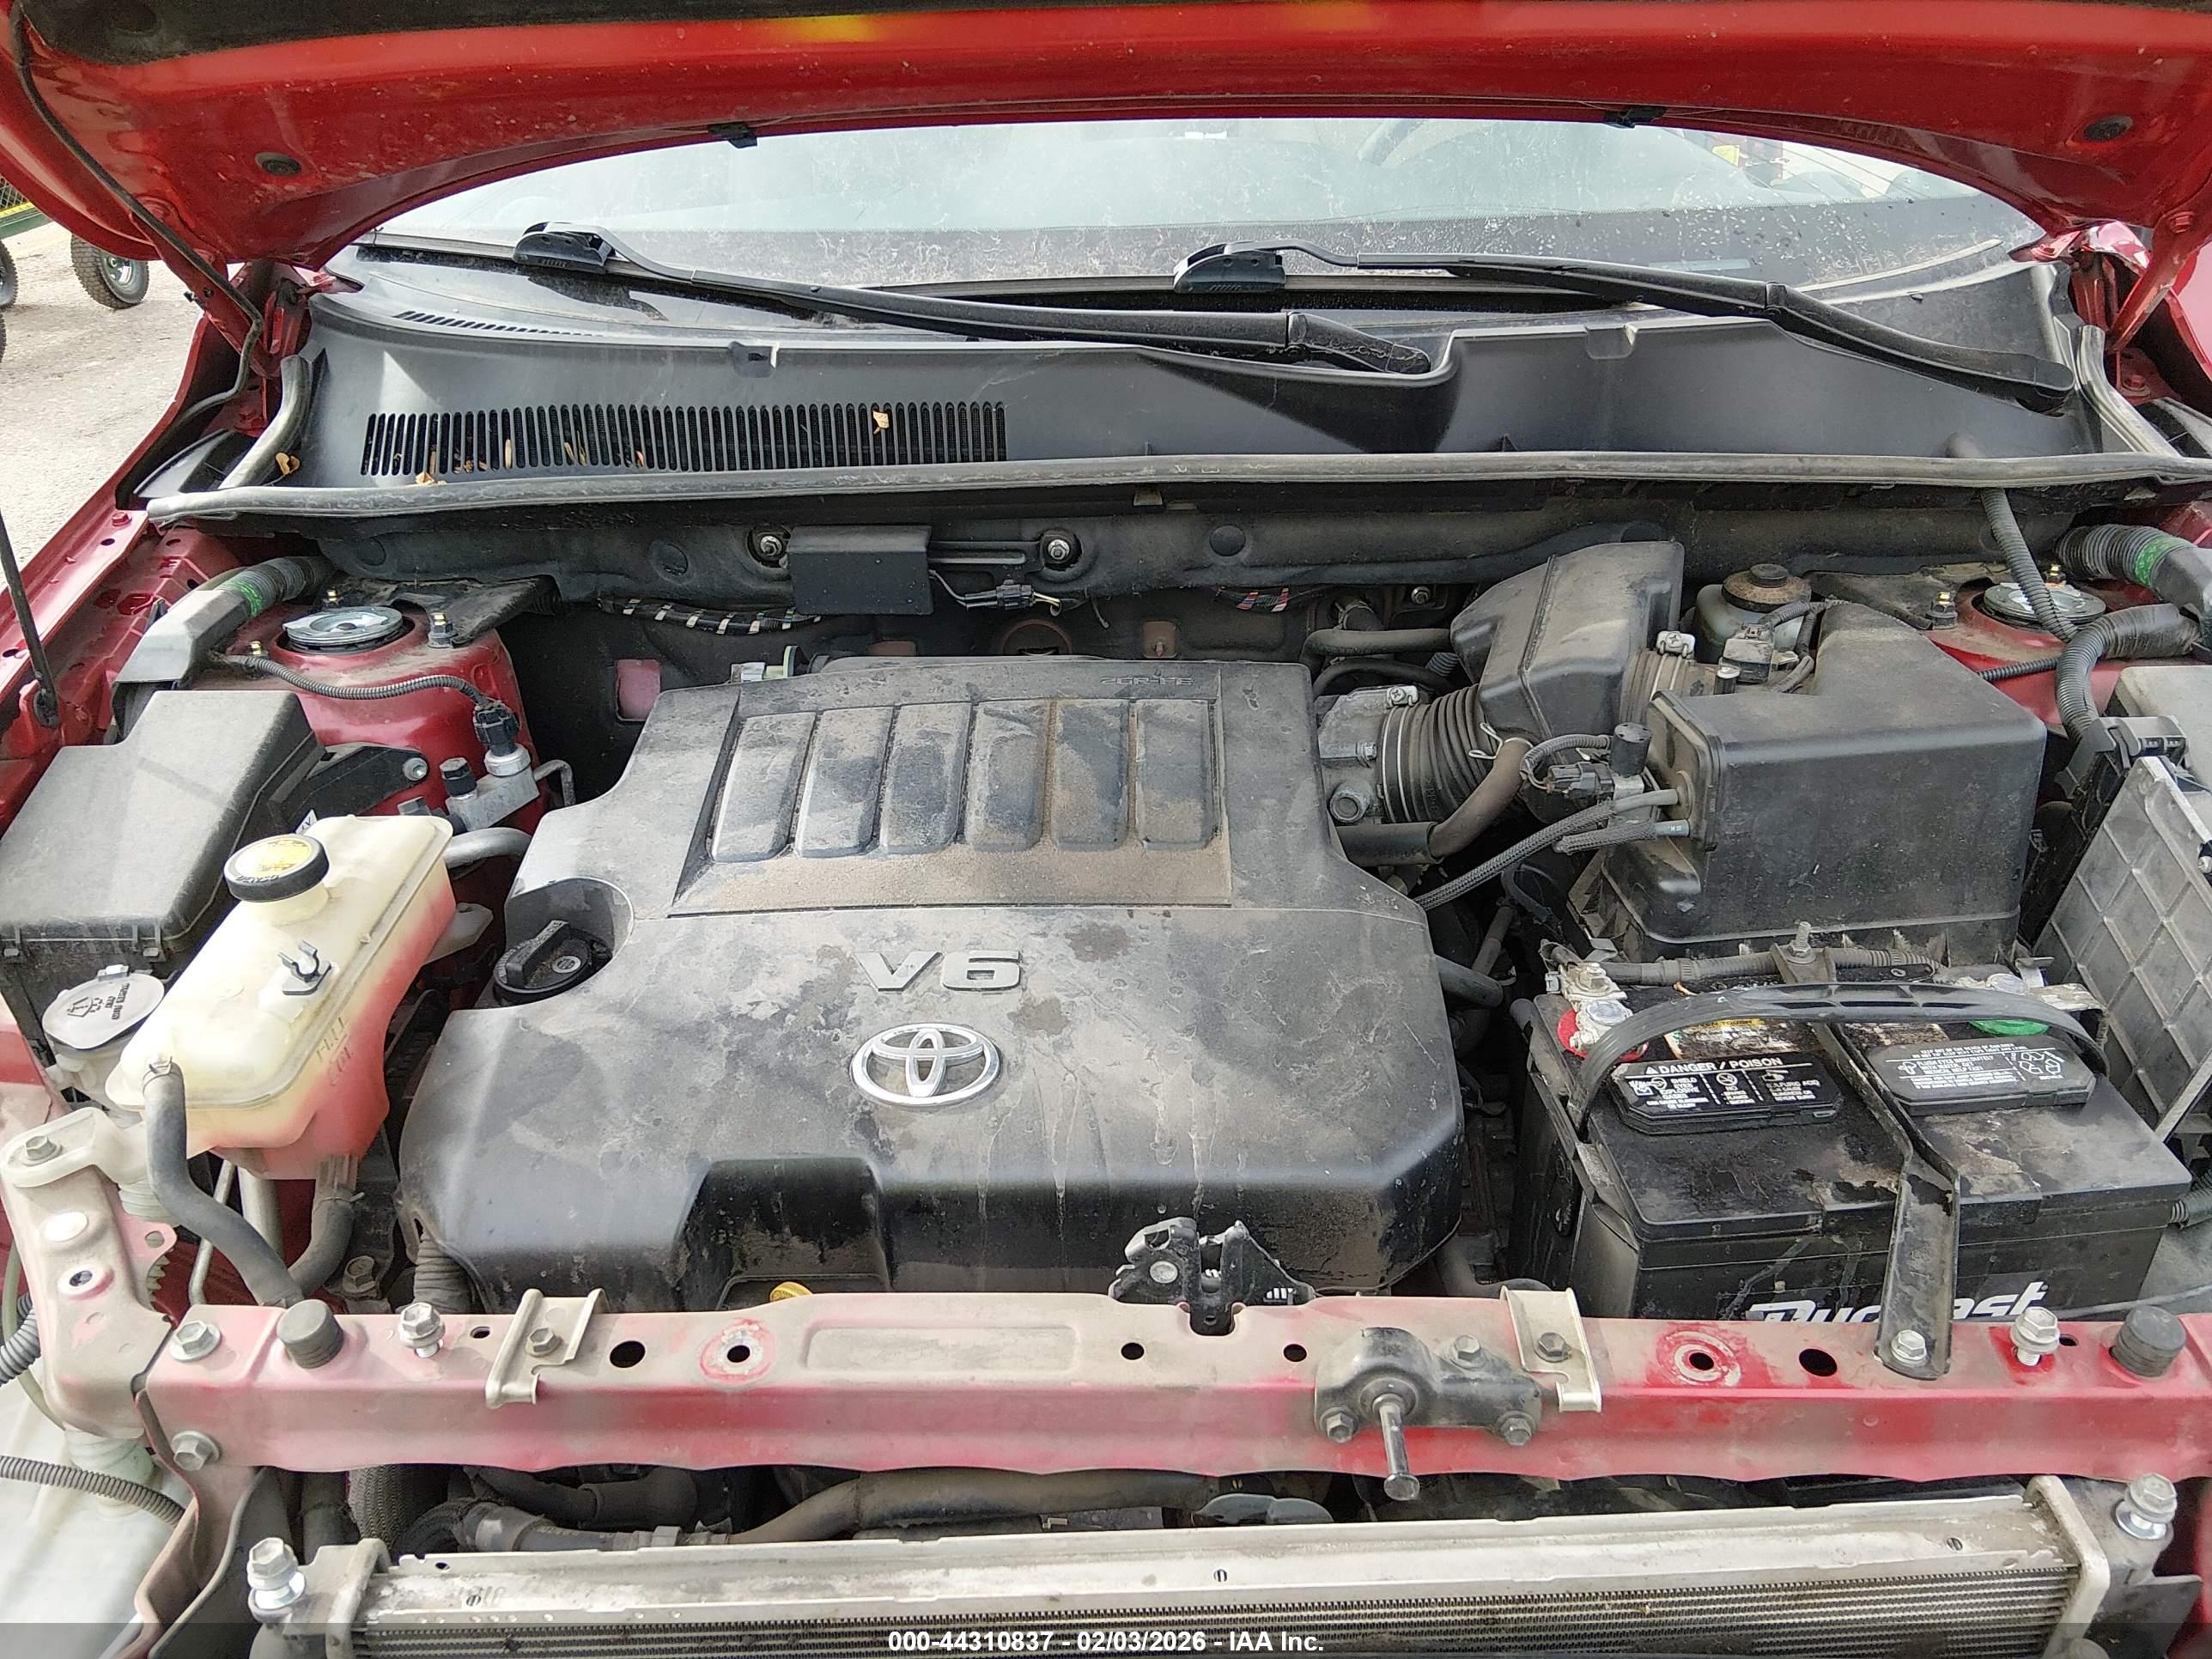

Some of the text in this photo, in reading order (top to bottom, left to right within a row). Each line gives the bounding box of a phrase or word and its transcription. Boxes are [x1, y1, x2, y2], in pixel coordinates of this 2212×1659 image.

[853, 950, 1022, 993] V6
[1658, 1057, 1784, 1074] DANGER / POISON
